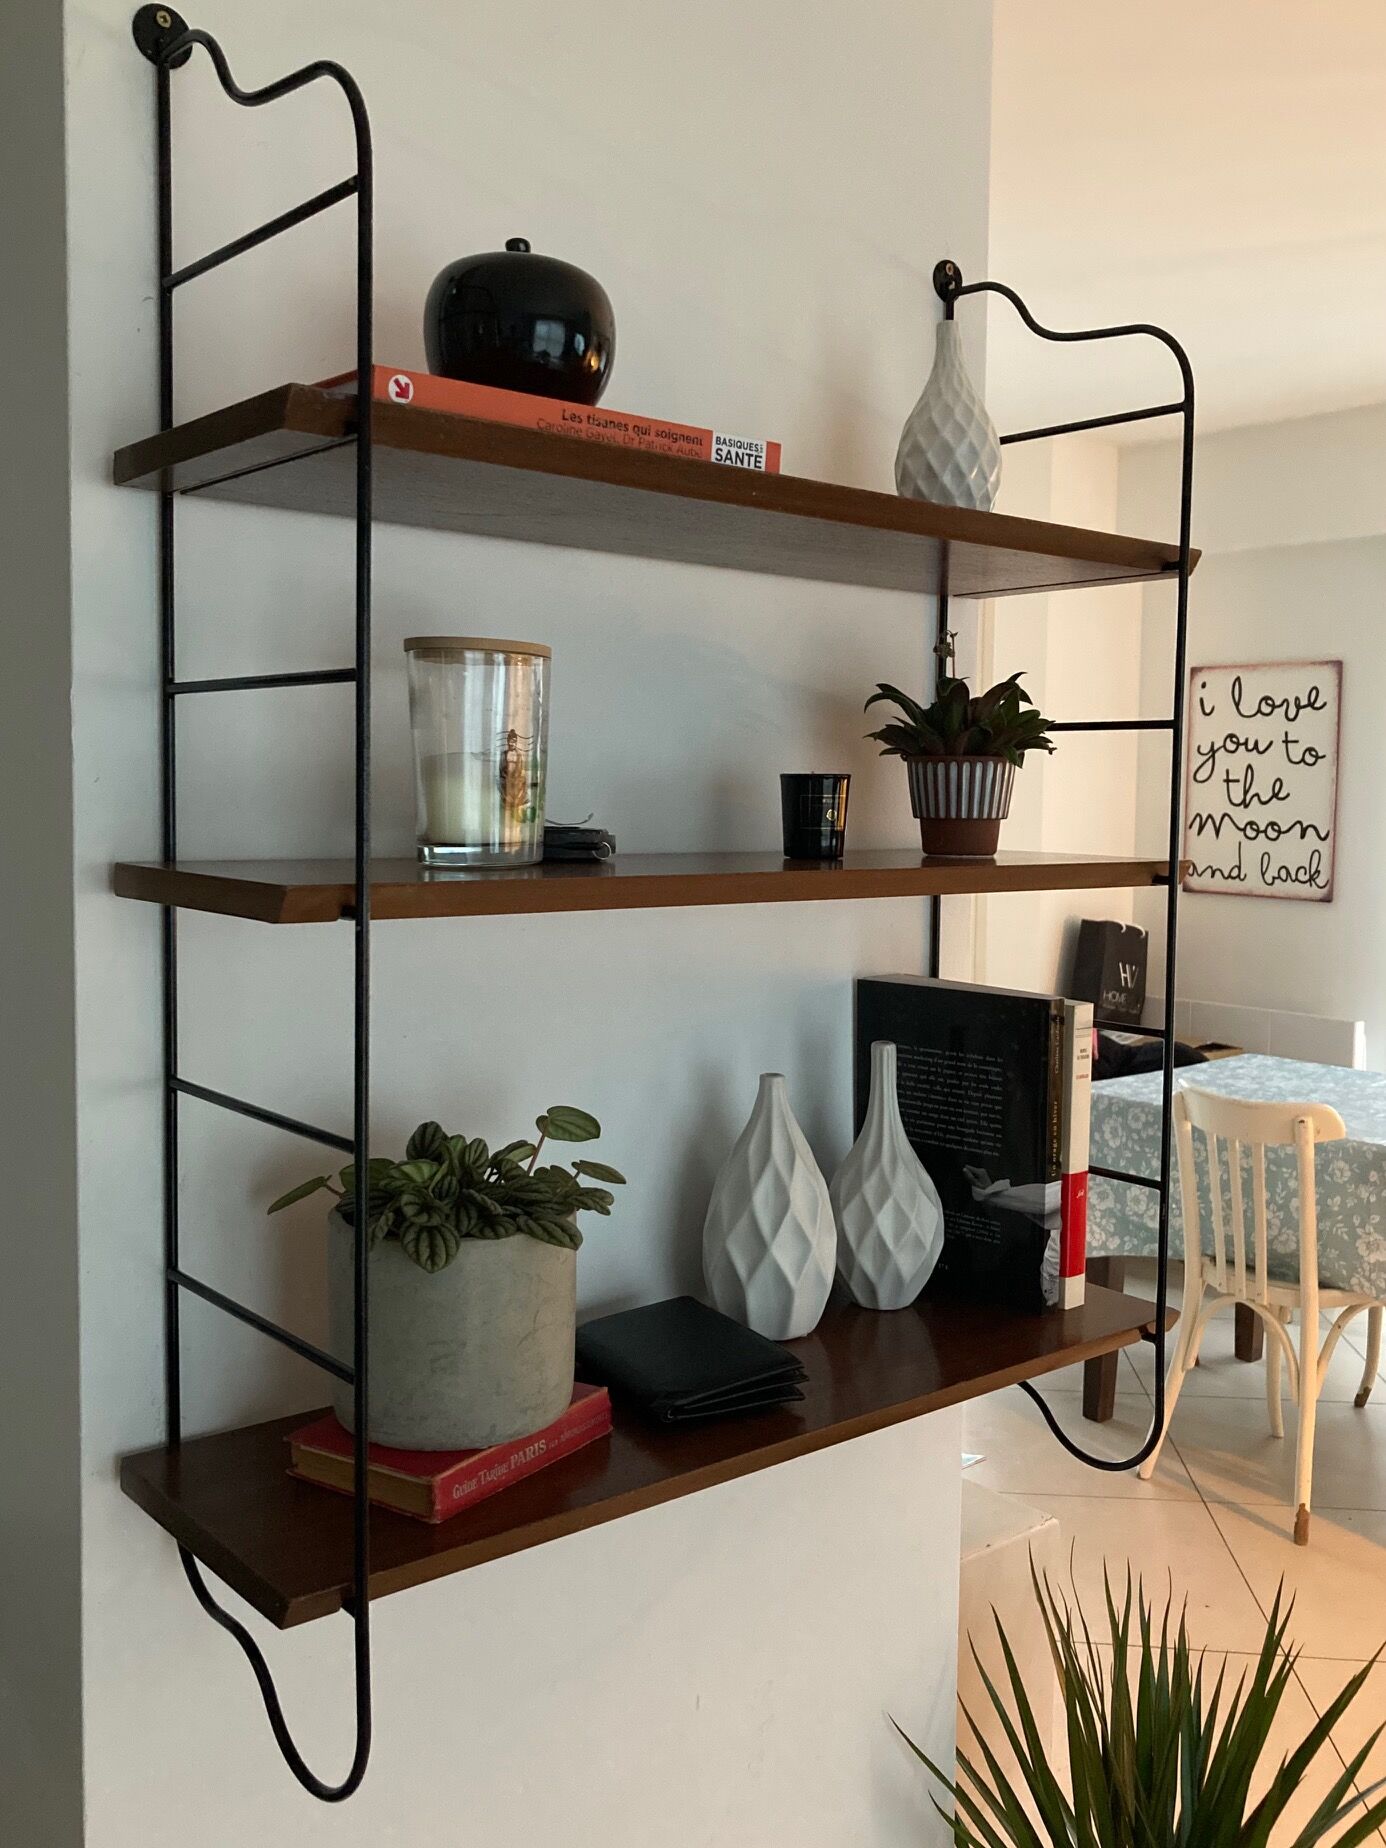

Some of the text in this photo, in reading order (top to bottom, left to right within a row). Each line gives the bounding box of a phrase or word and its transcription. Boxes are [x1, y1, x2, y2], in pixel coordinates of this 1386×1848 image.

[562, 409, 703, 446] Les tisanes qui soignent
[716, 436, 760, 453] BASIQUES
[1199, 675, 1328, 722] i love
[1193, 731, 1326, 784] you to
[1223, 763, 1291, 809] the
[1261, 849, 1329, 890] back
[510, 1440, 546, 1469] PARIS
